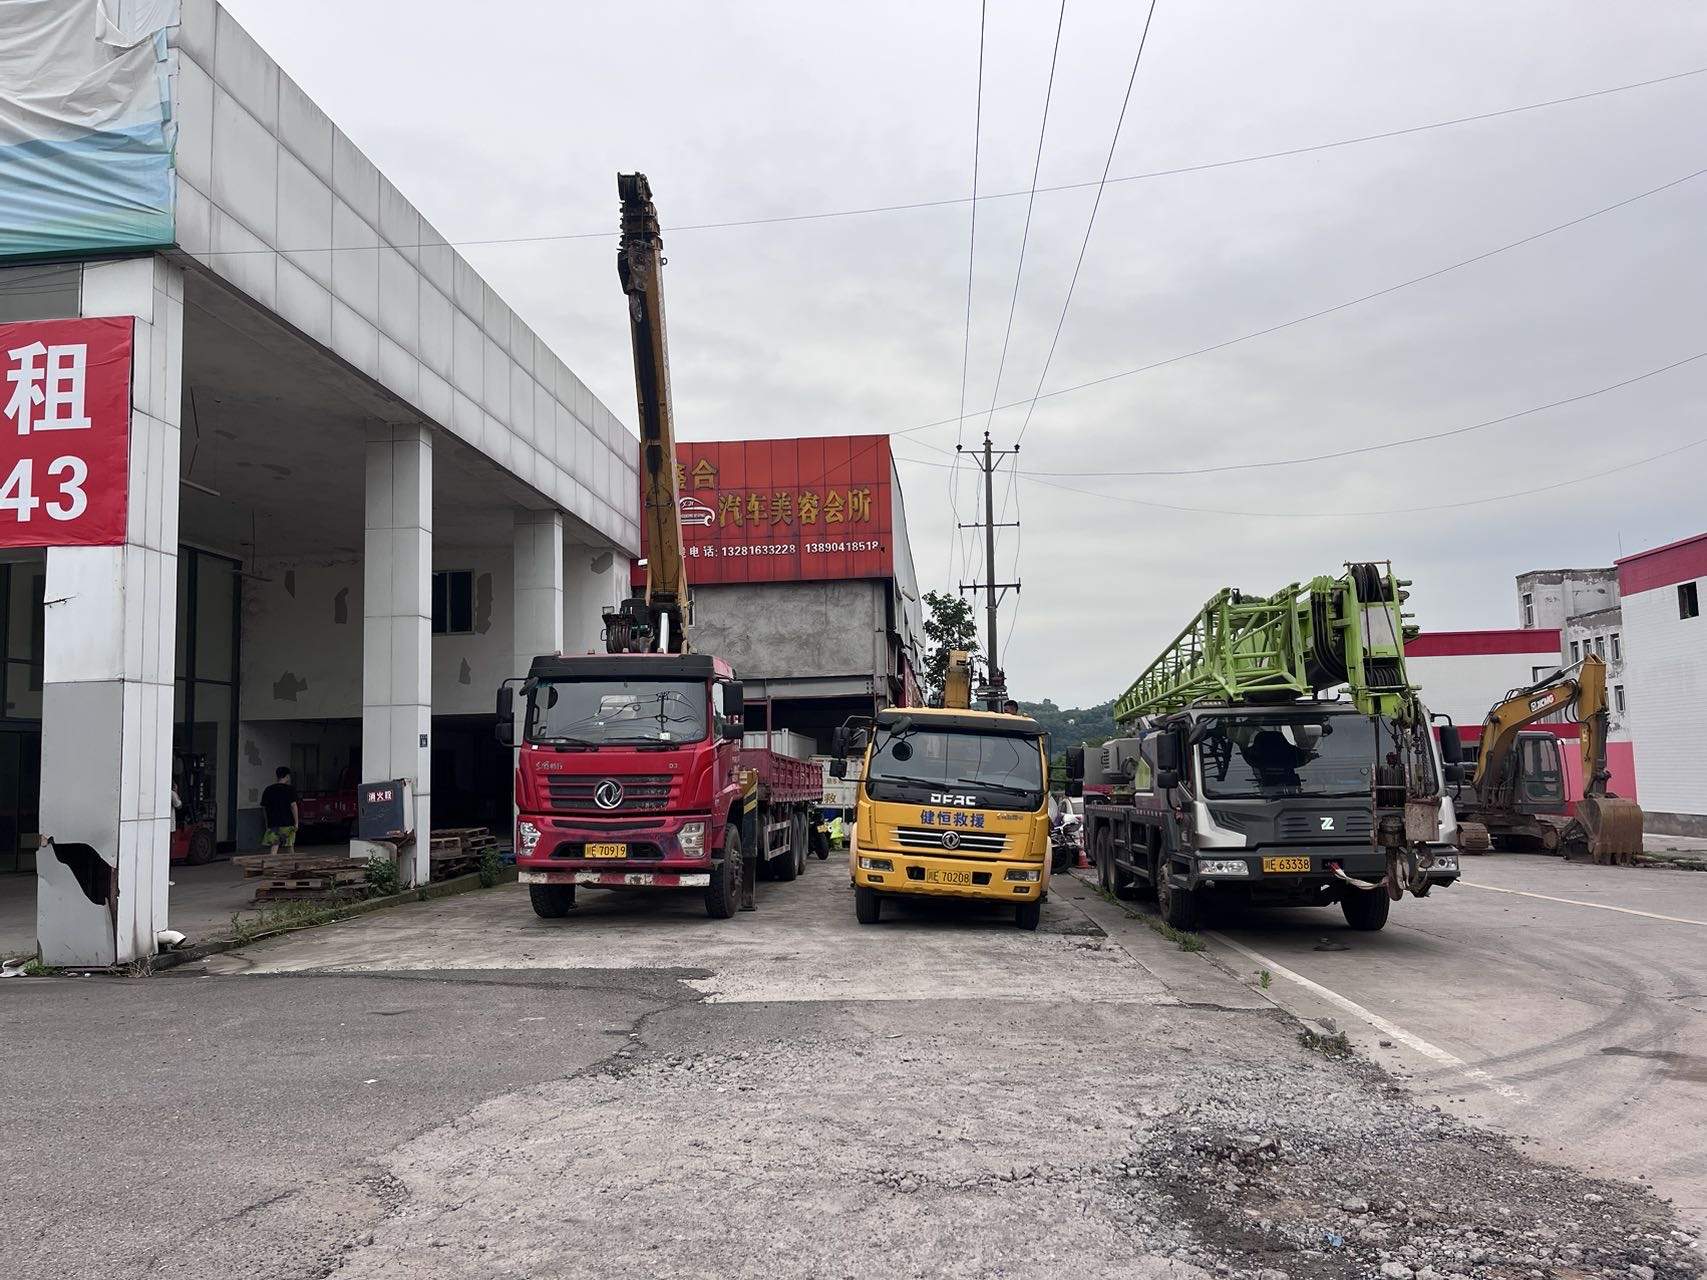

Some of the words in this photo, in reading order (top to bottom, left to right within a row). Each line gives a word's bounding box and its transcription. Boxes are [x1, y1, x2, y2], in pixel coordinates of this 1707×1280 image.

[3, 341, 92, 435] 租
[0, 455, 88, 522] 43
[719, 487, 873, 528] 汽车美容会所
[721, 544, 796, 558] 13281633228
[805, 540, 879, 553] 13890418518
[930, 793, 977, 806] DFAC
[920, 809, 985, 828] 健恒救援
